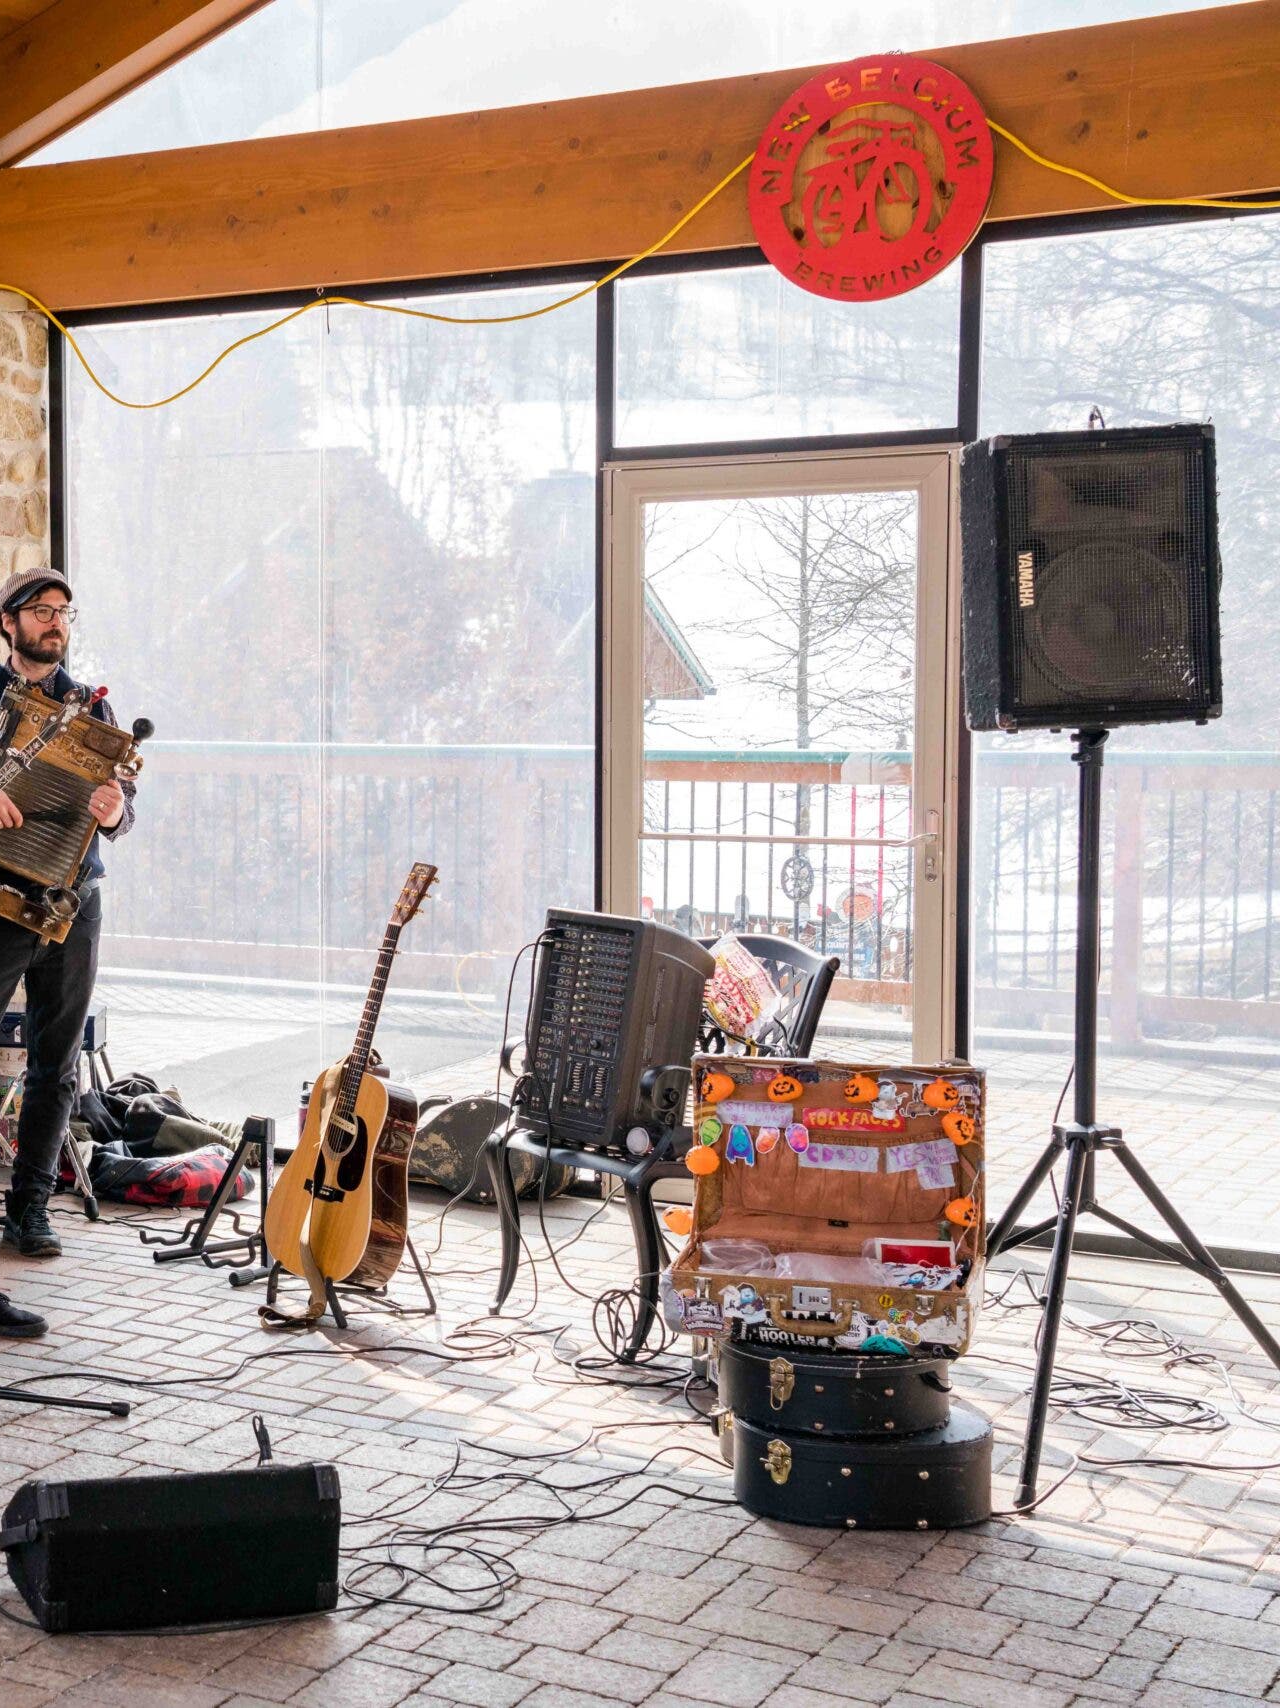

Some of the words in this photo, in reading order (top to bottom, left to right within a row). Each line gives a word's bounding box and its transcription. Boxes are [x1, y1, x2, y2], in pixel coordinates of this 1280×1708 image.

[825, 68, 979, 169] BELGIUM
[793, 247, 943, 294] BREWING
[1018, 552, 1035, 607] YAMAHA
[808, 1110, 849, 1126] FOLK
[890, 1145, 927, 1167] YES
